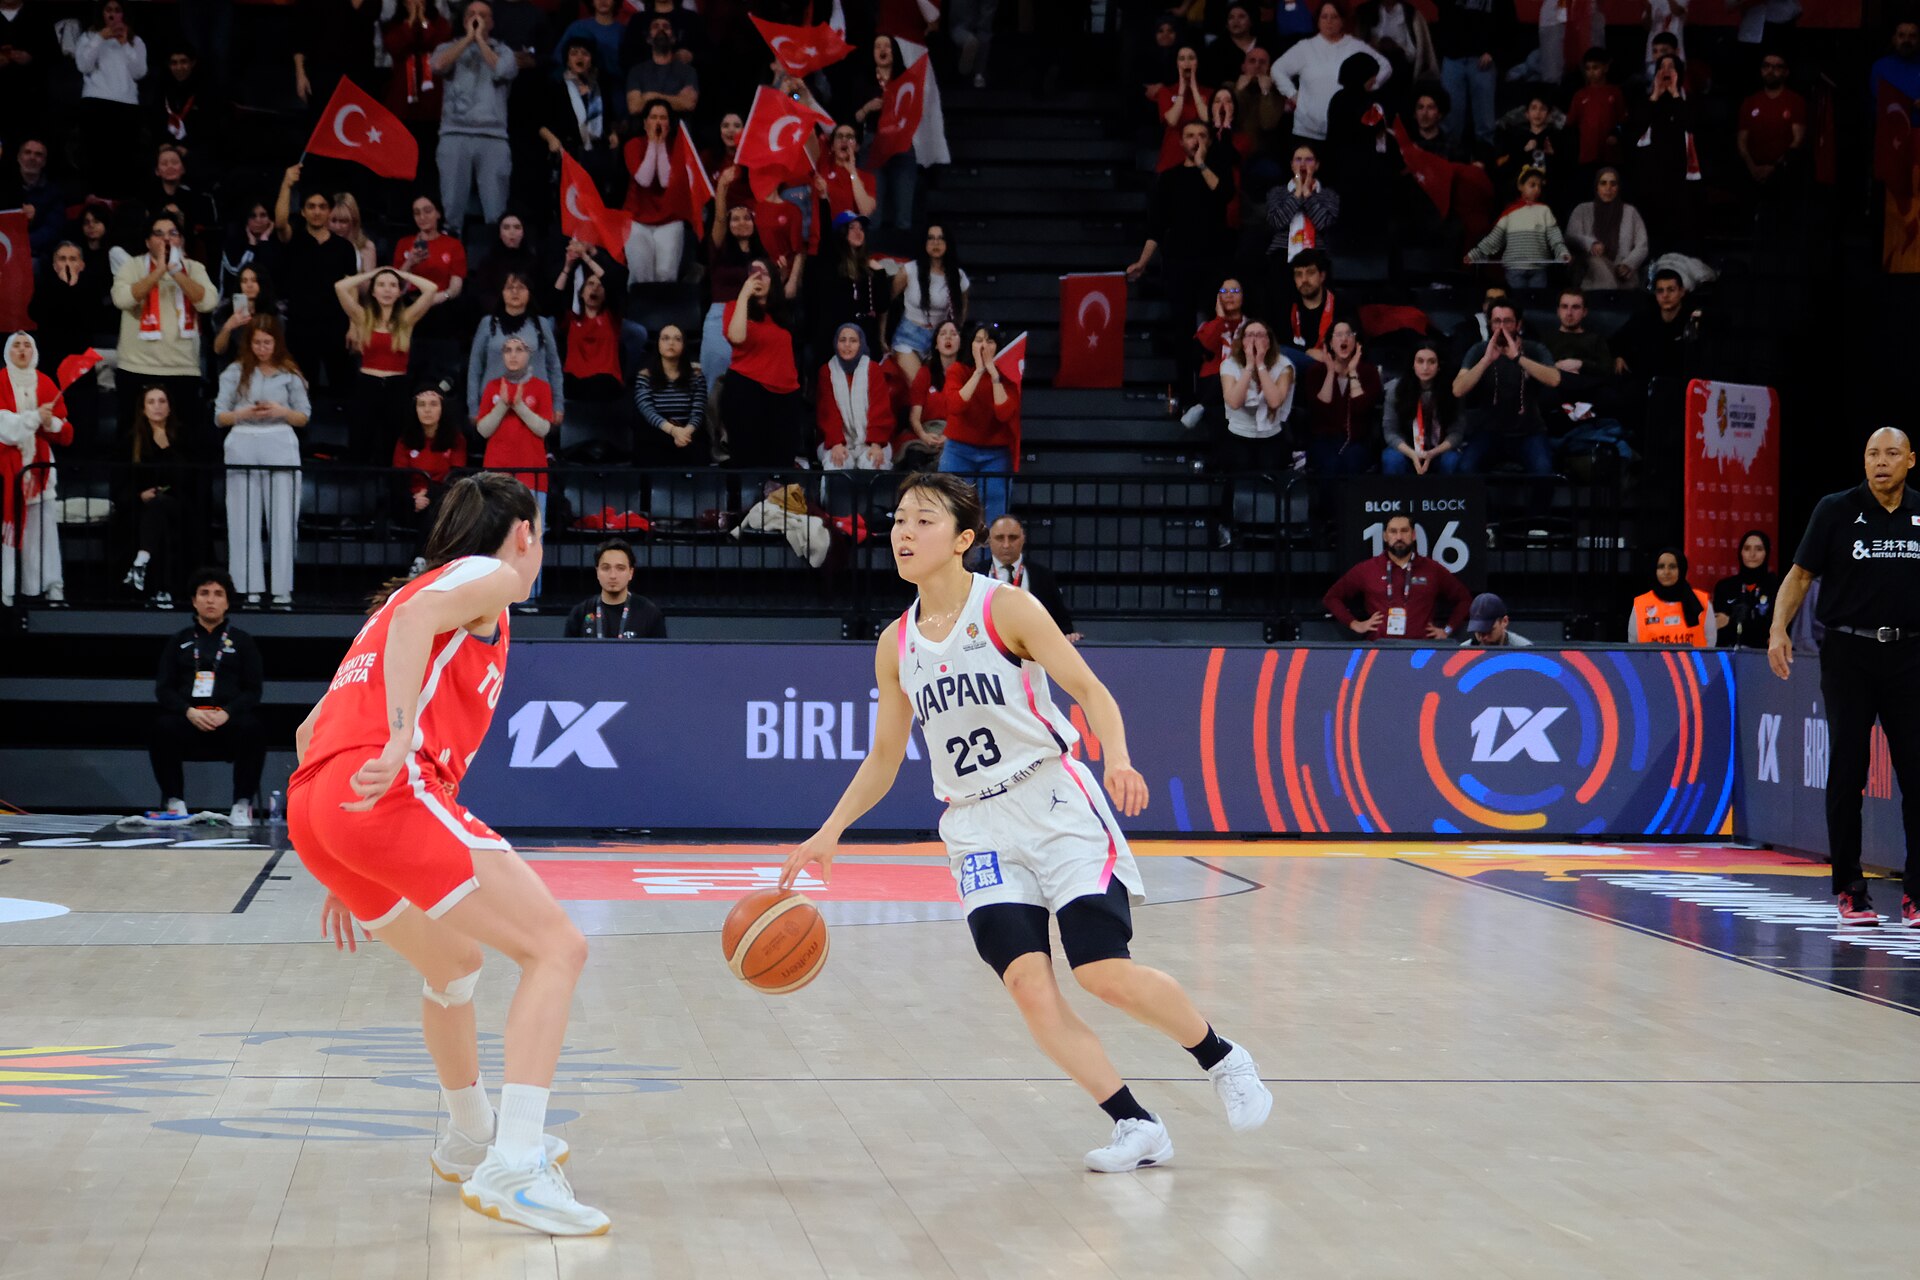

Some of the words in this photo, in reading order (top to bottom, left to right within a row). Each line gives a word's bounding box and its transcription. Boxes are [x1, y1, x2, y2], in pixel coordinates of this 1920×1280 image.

[1365, 501, 1401, 512] BLOK
[1422, 500, 1465, 511] BLOCK
[1872, 540, 1920, 551] 三井不動
[915, 673, 1006, 727] JAPAN
[946, 727, 1002, 777] 23
[781, 941, 819, 979] molten
